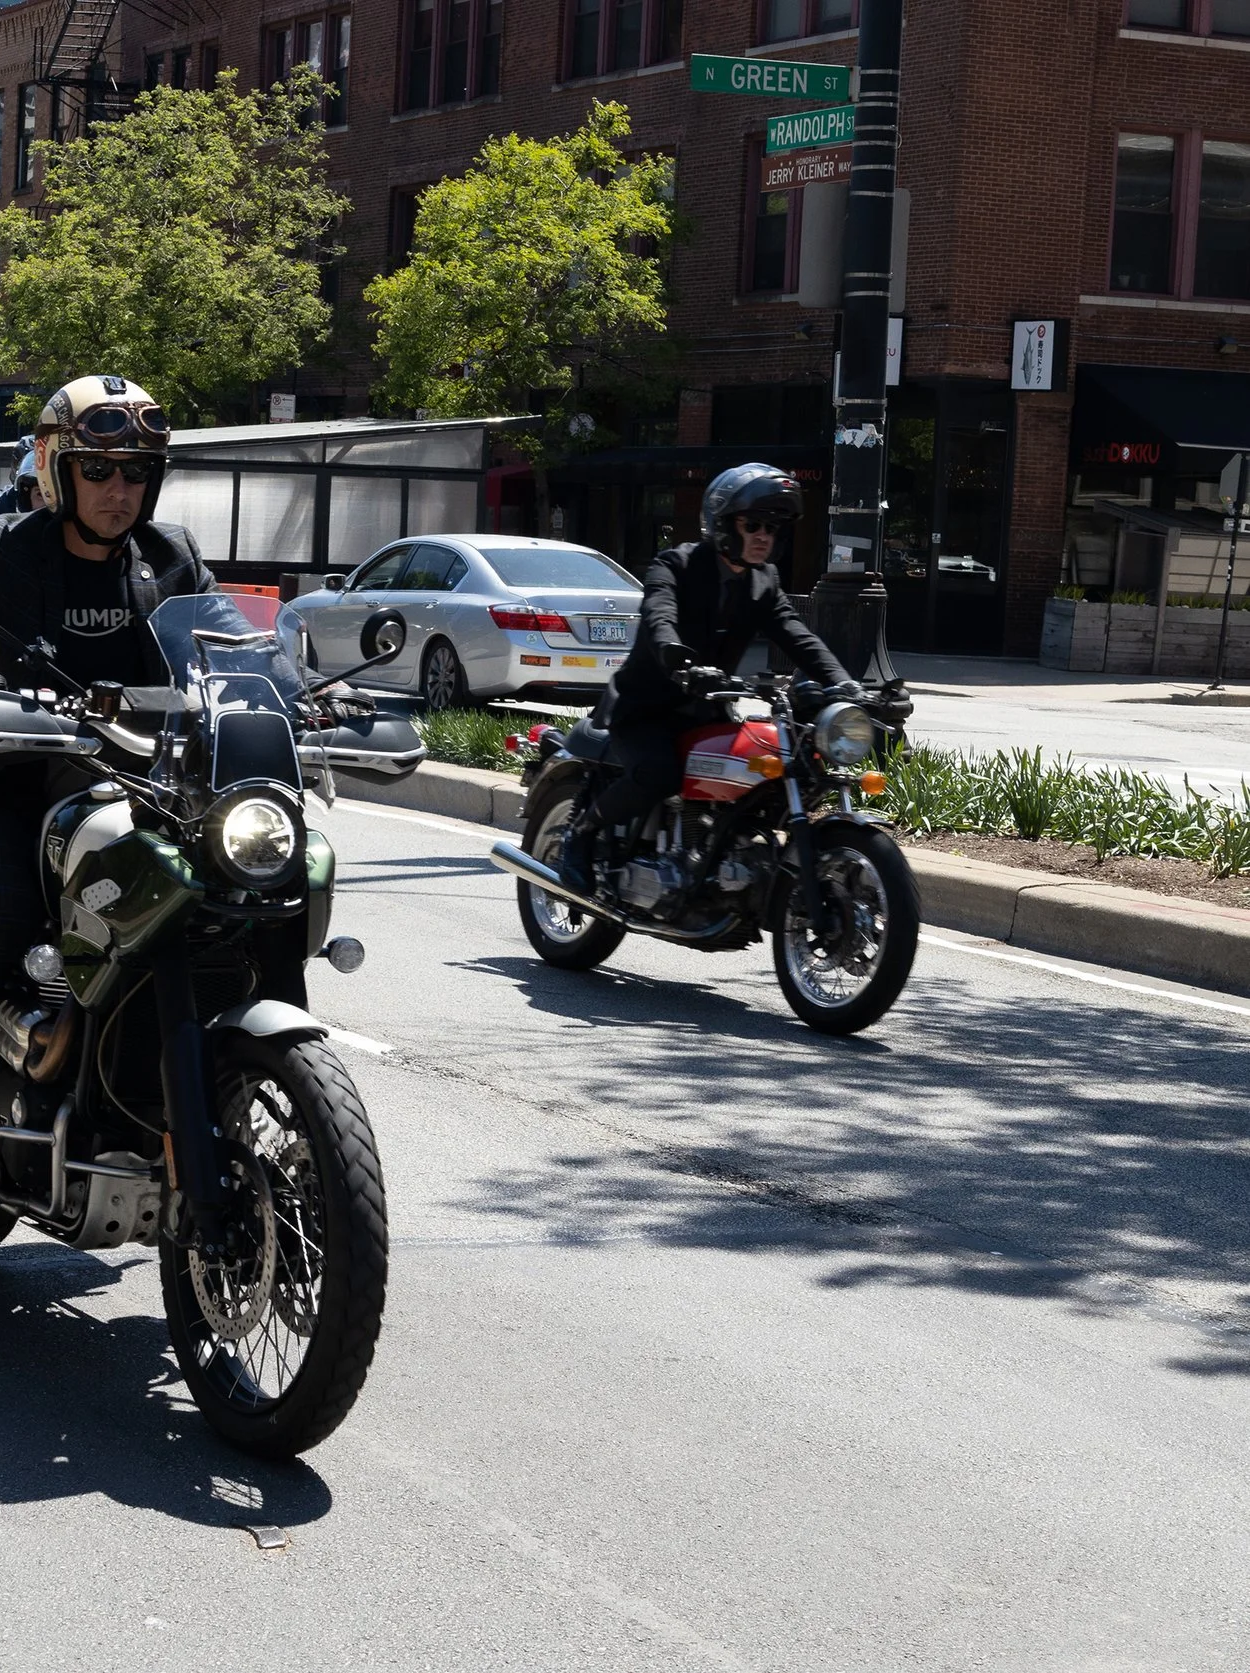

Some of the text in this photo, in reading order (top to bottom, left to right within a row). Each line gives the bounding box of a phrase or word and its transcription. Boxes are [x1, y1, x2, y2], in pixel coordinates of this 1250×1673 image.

[706, 63, 838, 94] N GREEN ST
[770, 128, 777, 142] W
[776, 111, 846, 146] RANDOLPH
[795, 155, 822, 166] HONORARY
[765, 161, 852, 186] JERRY KLEINER WAY
[63, 608, 138, 630] IUMPH
[592, 627, 625, 638] 938 RTT
